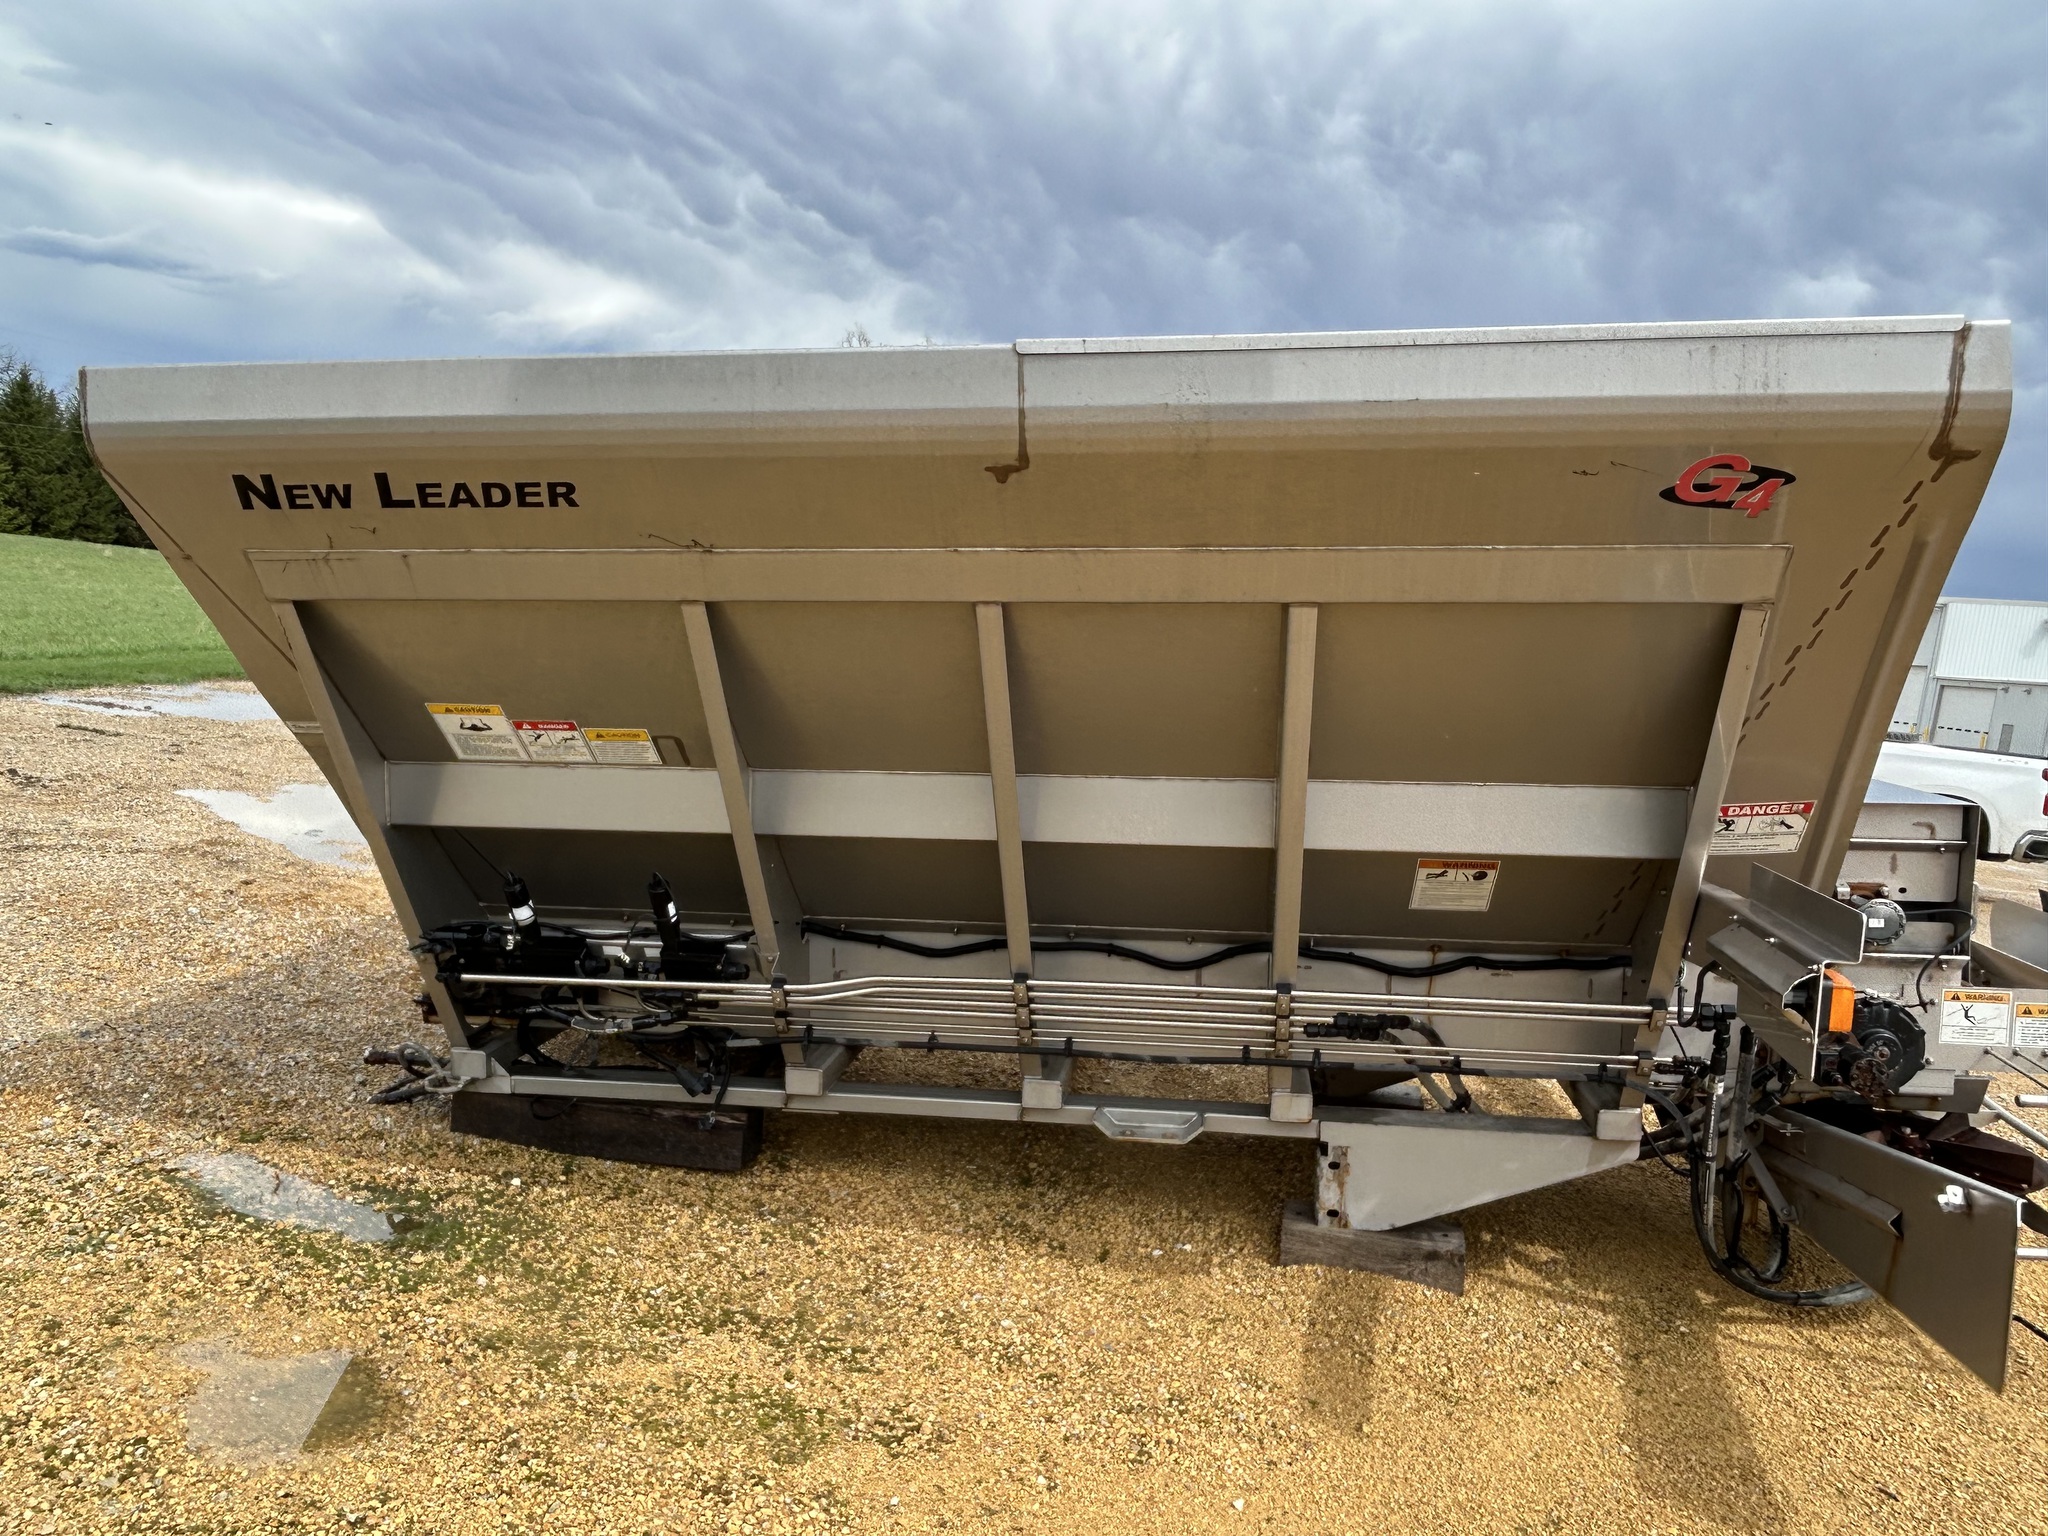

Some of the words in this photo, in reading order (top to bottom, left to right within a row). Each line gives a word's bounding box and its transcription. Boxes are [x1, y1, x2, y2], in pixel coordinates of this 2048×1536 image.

[1674, 453, 1785, 518] G4
[1727, 803, 1805, 816] DANGER
[1442, 860, 1496, 870] WARNING
[1964, 992, 2004, 1002] WARNING
